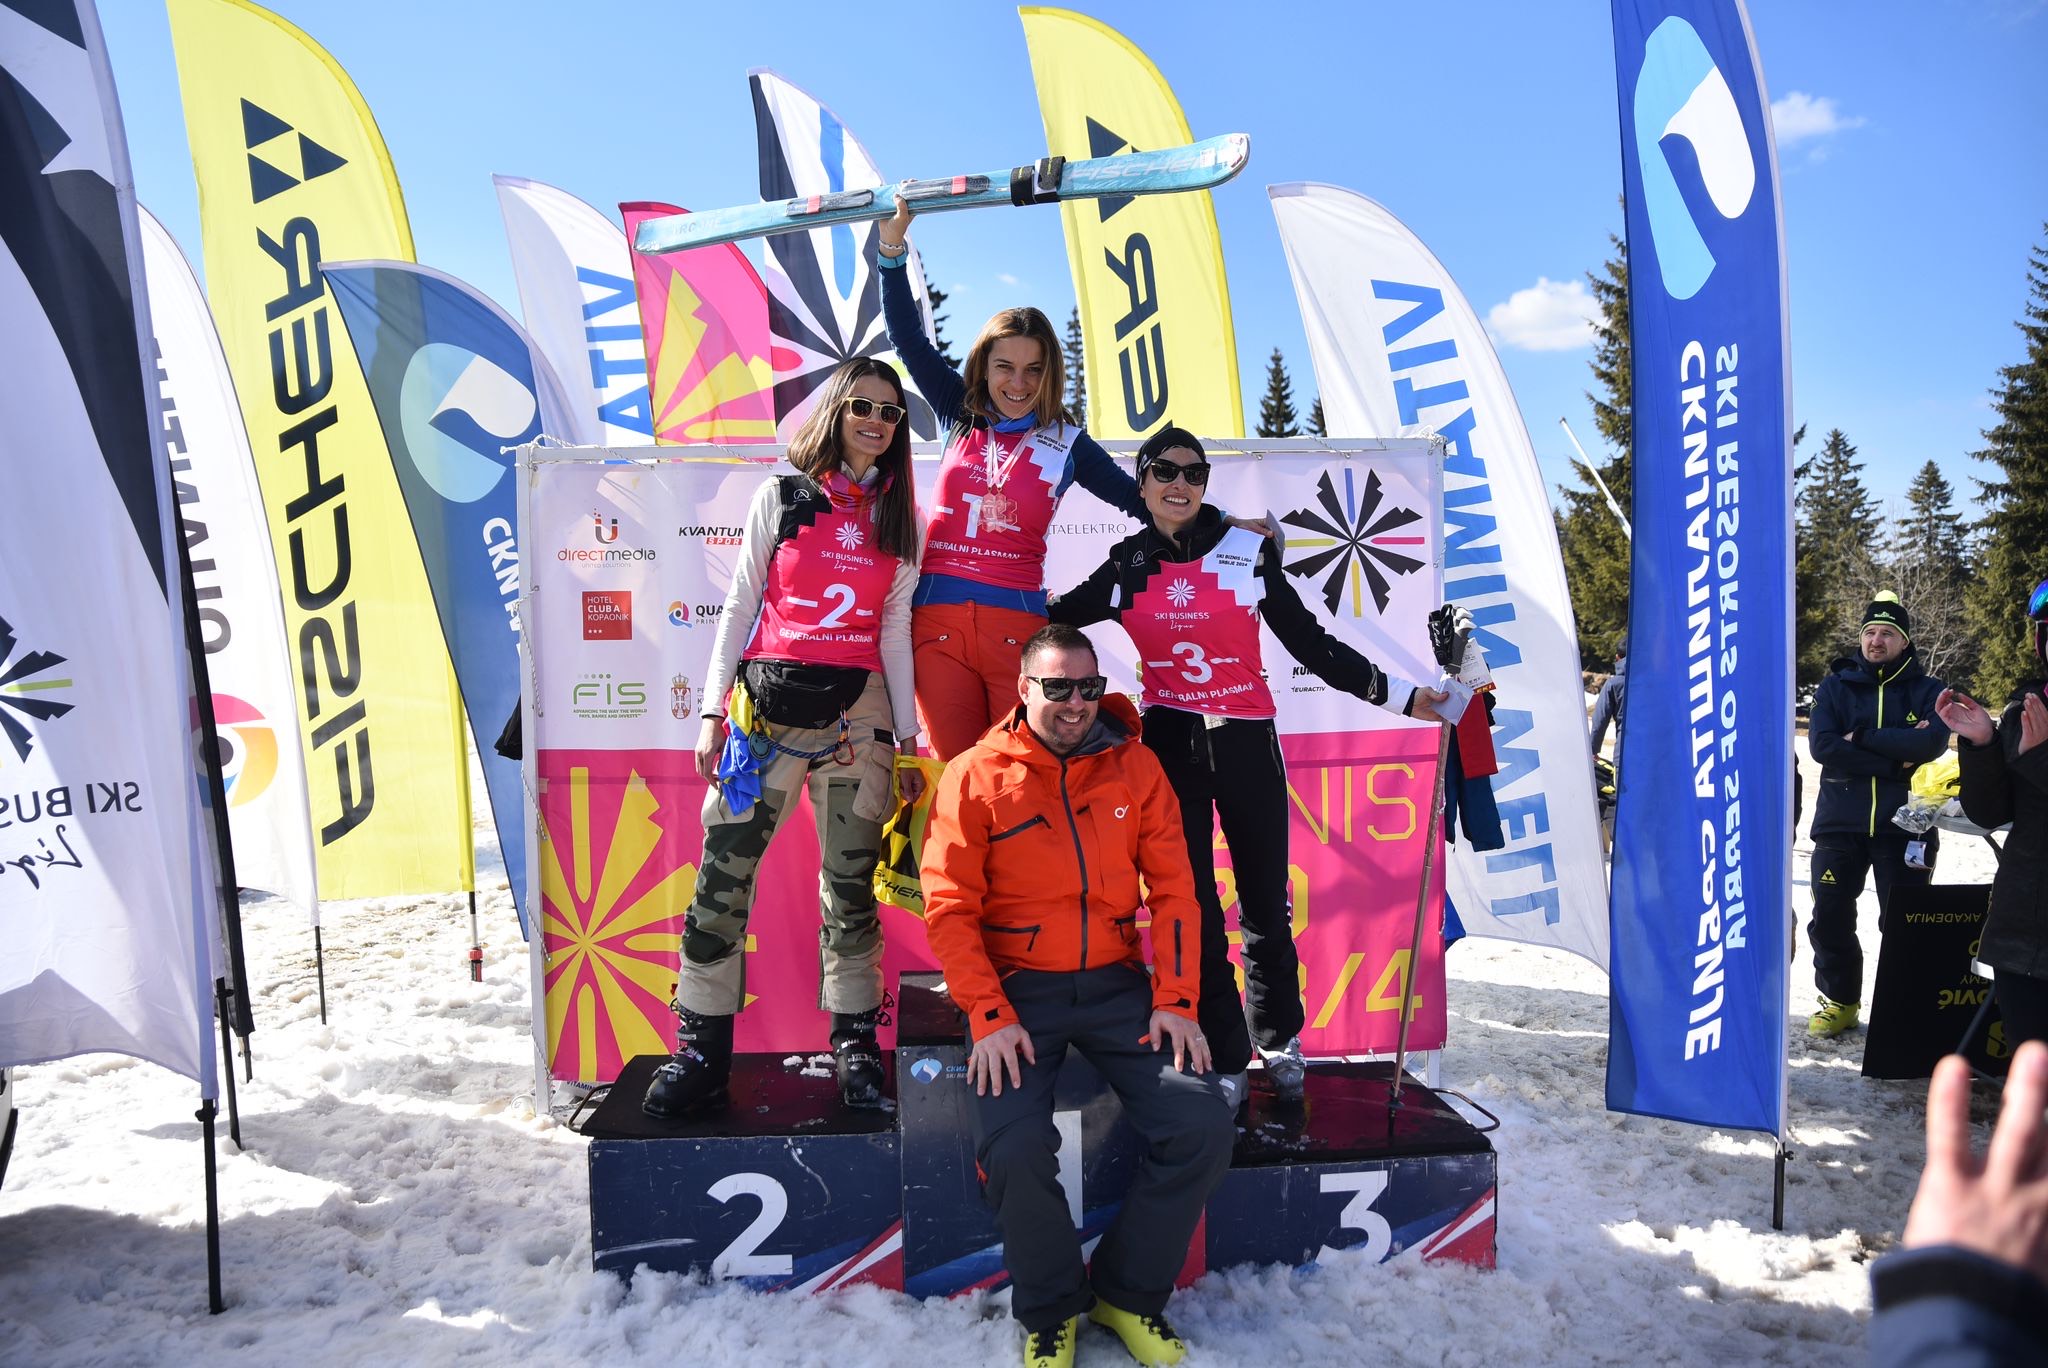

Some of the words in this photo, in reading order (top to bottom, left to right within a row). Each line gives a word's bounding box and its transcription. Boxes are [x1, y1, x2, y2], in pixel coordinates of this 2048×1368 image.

[1069, 156, 1200, 181] FISCHE
[960, 460, 972, 468] SKI
[820, 550, 834, 560] SKI
[835, 552, 874, 566] BUSINESS
[588, 596, 613, 604] HOTEL
[588, 605, 612, 613] CLUB
[588, 613, 630, 621] KOPAONIK
[1154, 612, 1168, 620] SKI
[1169, 612, 1210, 620] BUSINESS
[1905, 912, 1981, 923] AKADEMIJA
[1319, 1170, 1392, 1267] 3
[706, 1172, 794, 1278] 2
